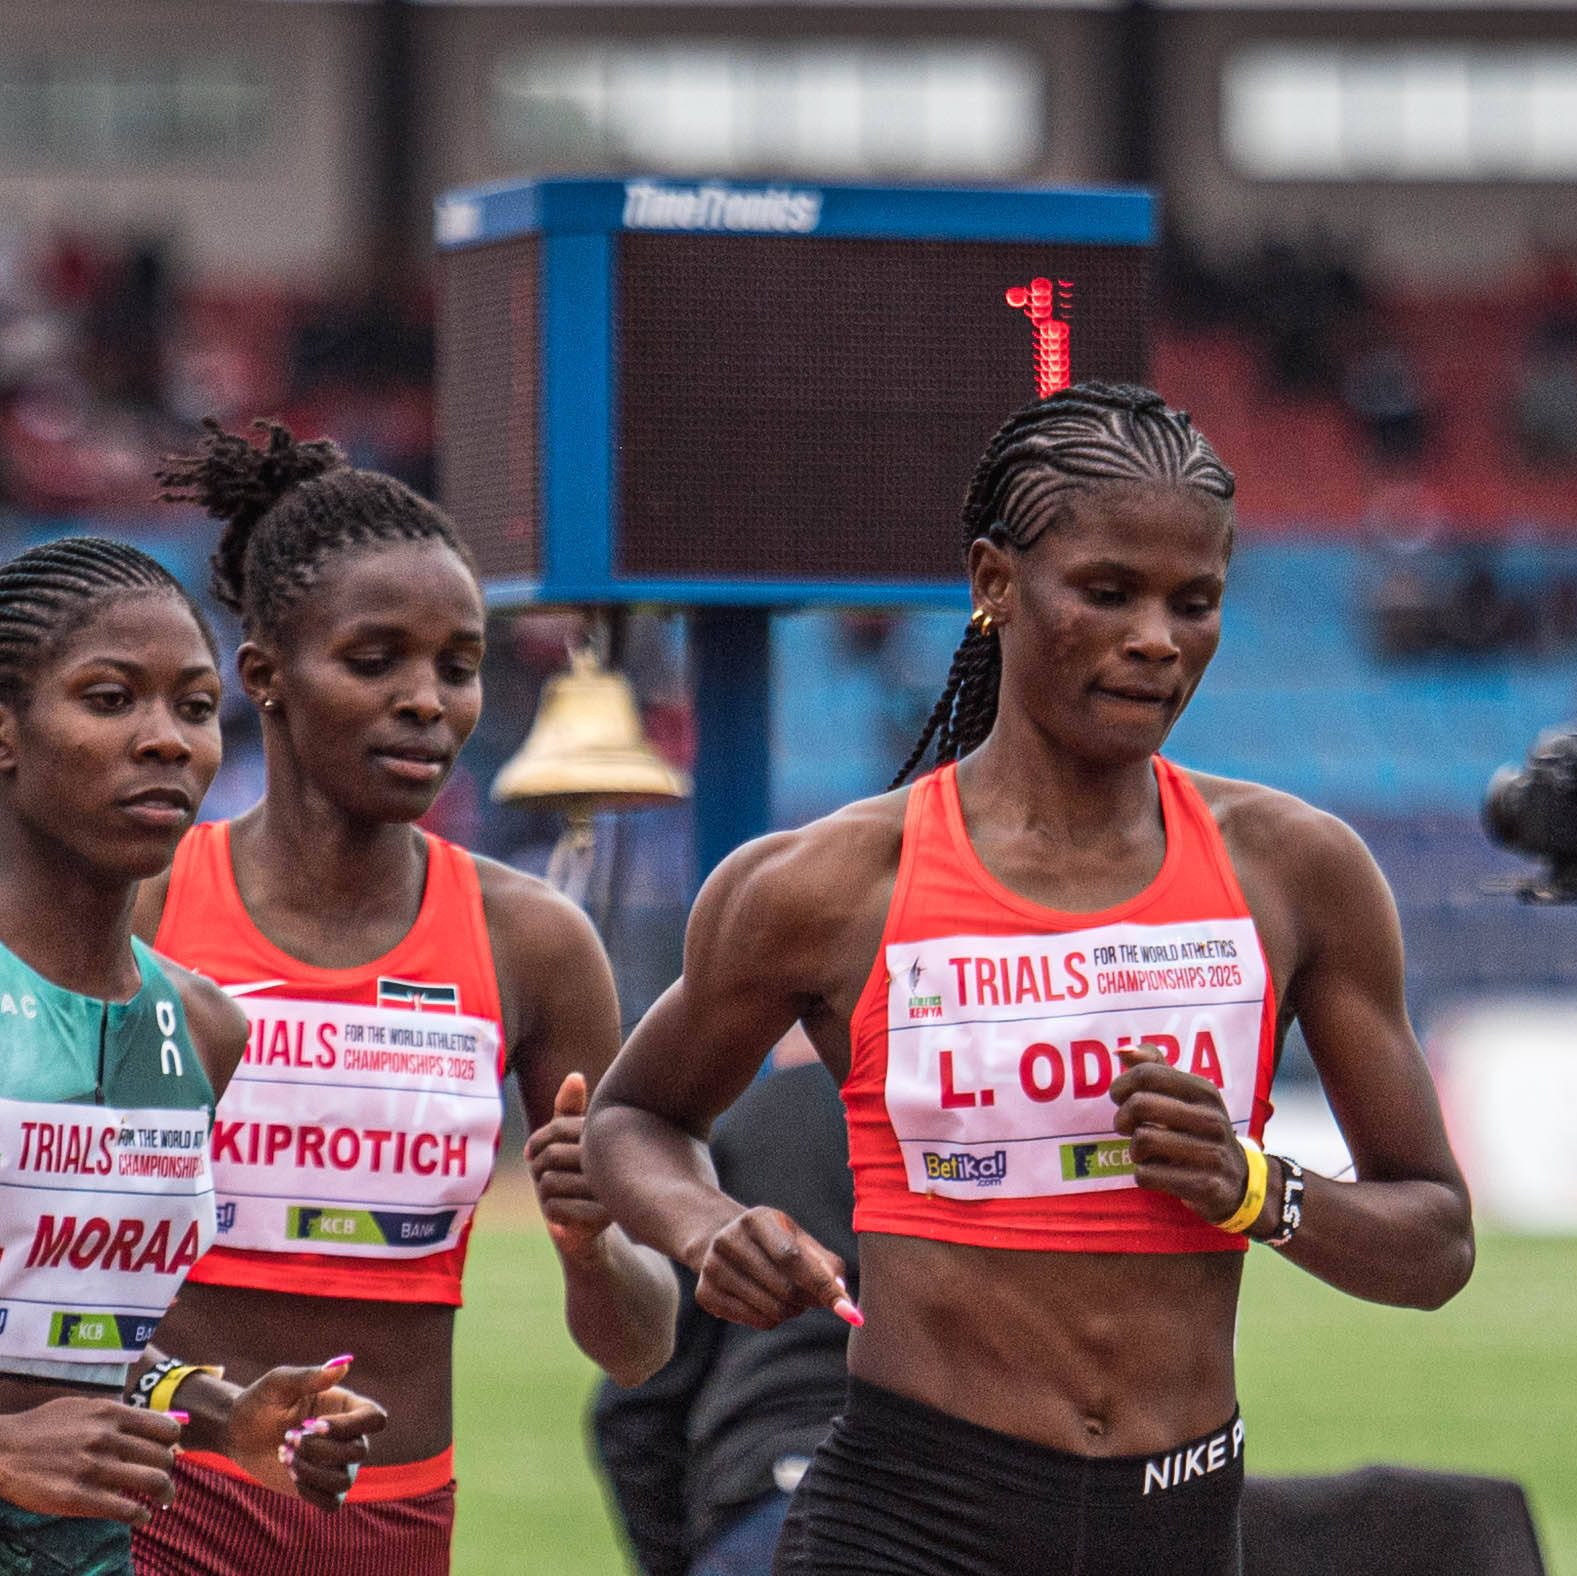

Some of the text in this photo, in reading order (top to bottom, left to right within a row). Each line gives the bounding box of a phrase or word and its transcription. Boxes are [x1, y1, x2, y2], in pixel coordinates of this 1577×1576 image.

[1093, 940, 1237, 966] FOR THE WORLD ATHLETICS
[949, 951, 1090, 1007] TRIALS
[1097, 965, 1242, 995] CHAMPIONSHIPS 2025
[909, 1006, 943, 1018] KENYA
[242, 1018, 338, 1070] IALS
[344, 1024, 477, 1053] FOR THE WORLD ATHLETICS
[343, 1048, 476, 1081] CHAMPIONSHIPS 2025
[939, 1050, 994, 1109] L.
[17, 1121, 116, 1176] TRIALS
[118, 1128, 135, 1147] FOR
[137, 1128, 158, 1149] THE
[160, 1129, 191, 1150] WORLD
[210, 1120, 469, 1178] KIPROTICH
[924, 1151, 1006, 1181] Betika!
[1097, 1149, 1133, 1168] KCB
[320, 1216, 437, 1240] KCB BANK
[23, 1213, 200, 1275] MORAA
[79, 1323, 104, 1341] KCB
[1142, 1433, 1228, 1497] NIKE
